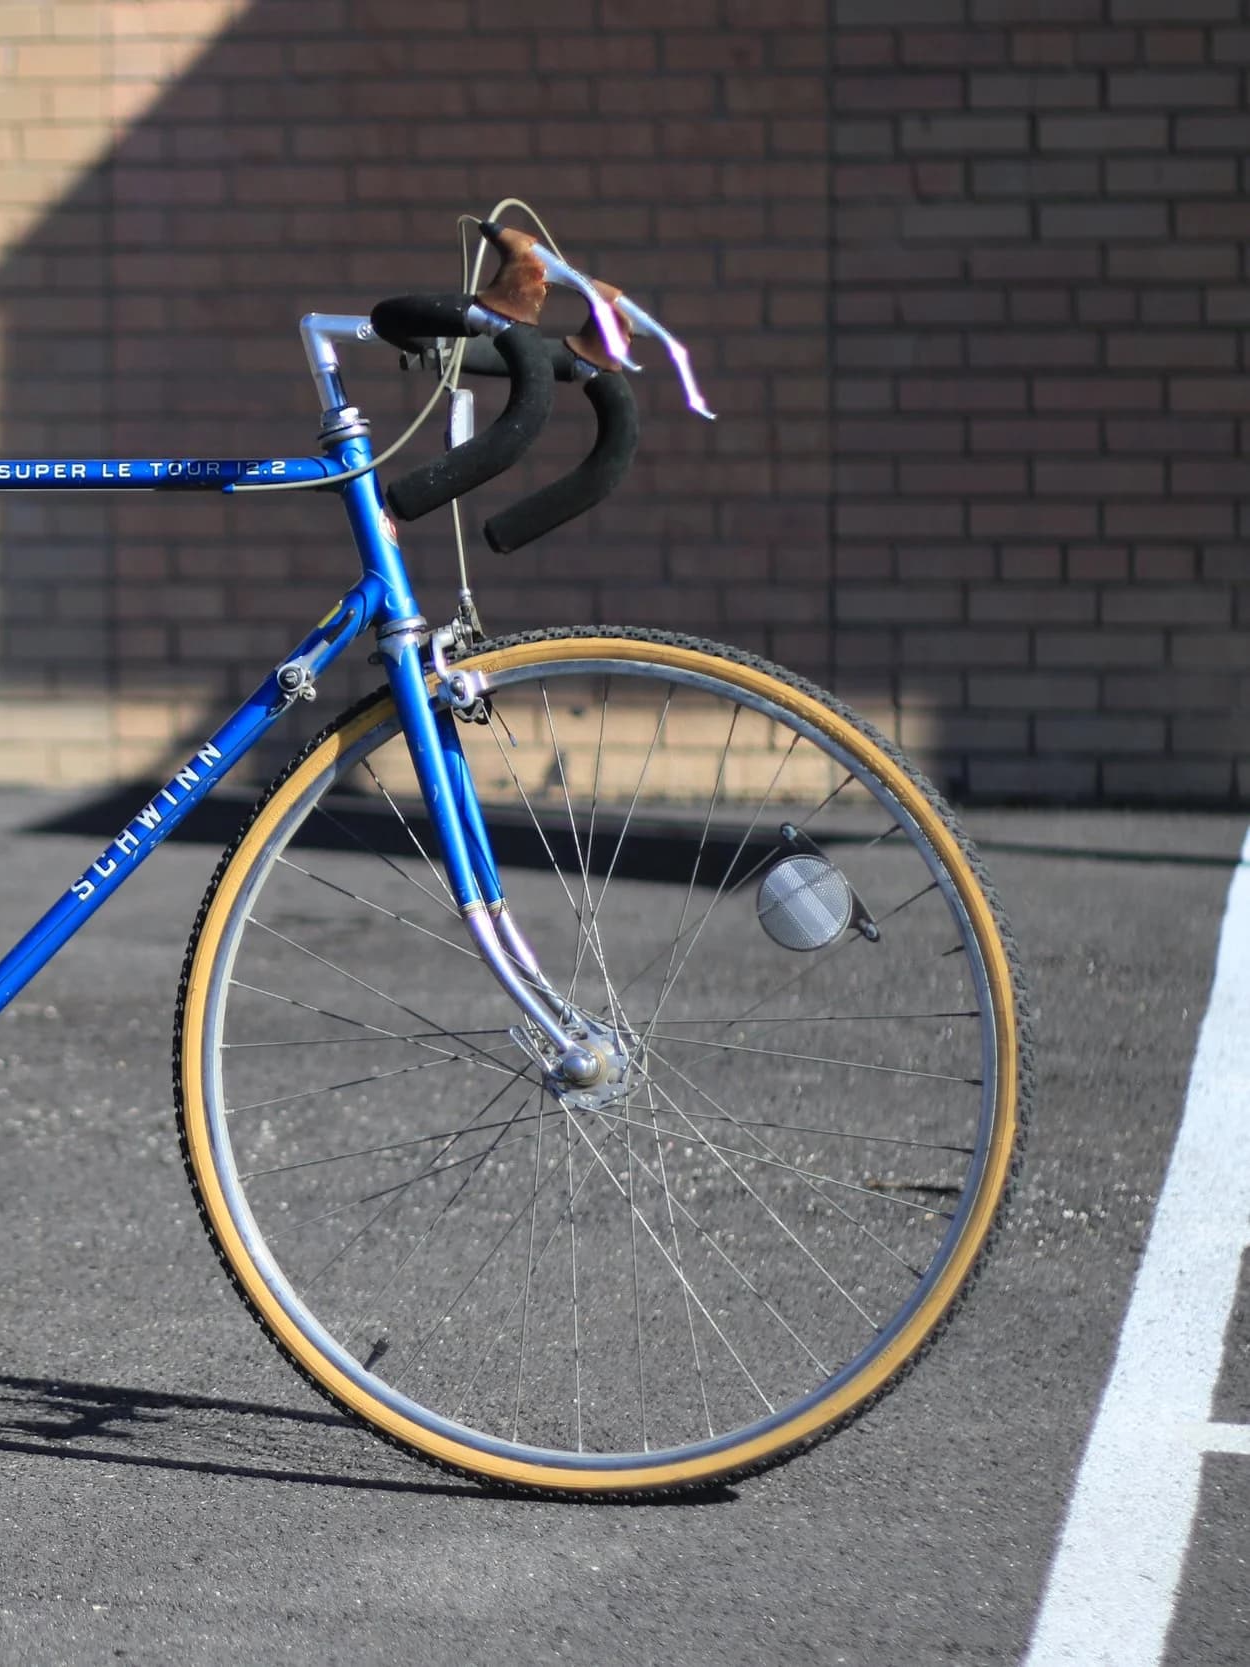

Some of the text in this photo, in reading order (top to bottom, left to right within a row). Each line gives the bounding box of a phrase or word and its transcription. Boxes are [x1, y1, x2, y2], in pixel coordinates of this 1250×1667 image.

[102, 463, 131, 478] LE
[150, 462, 220, 477] TOUR
[237, 461, 286, 475] 12.2
[70, 741, 222, 901] SCHWINN
